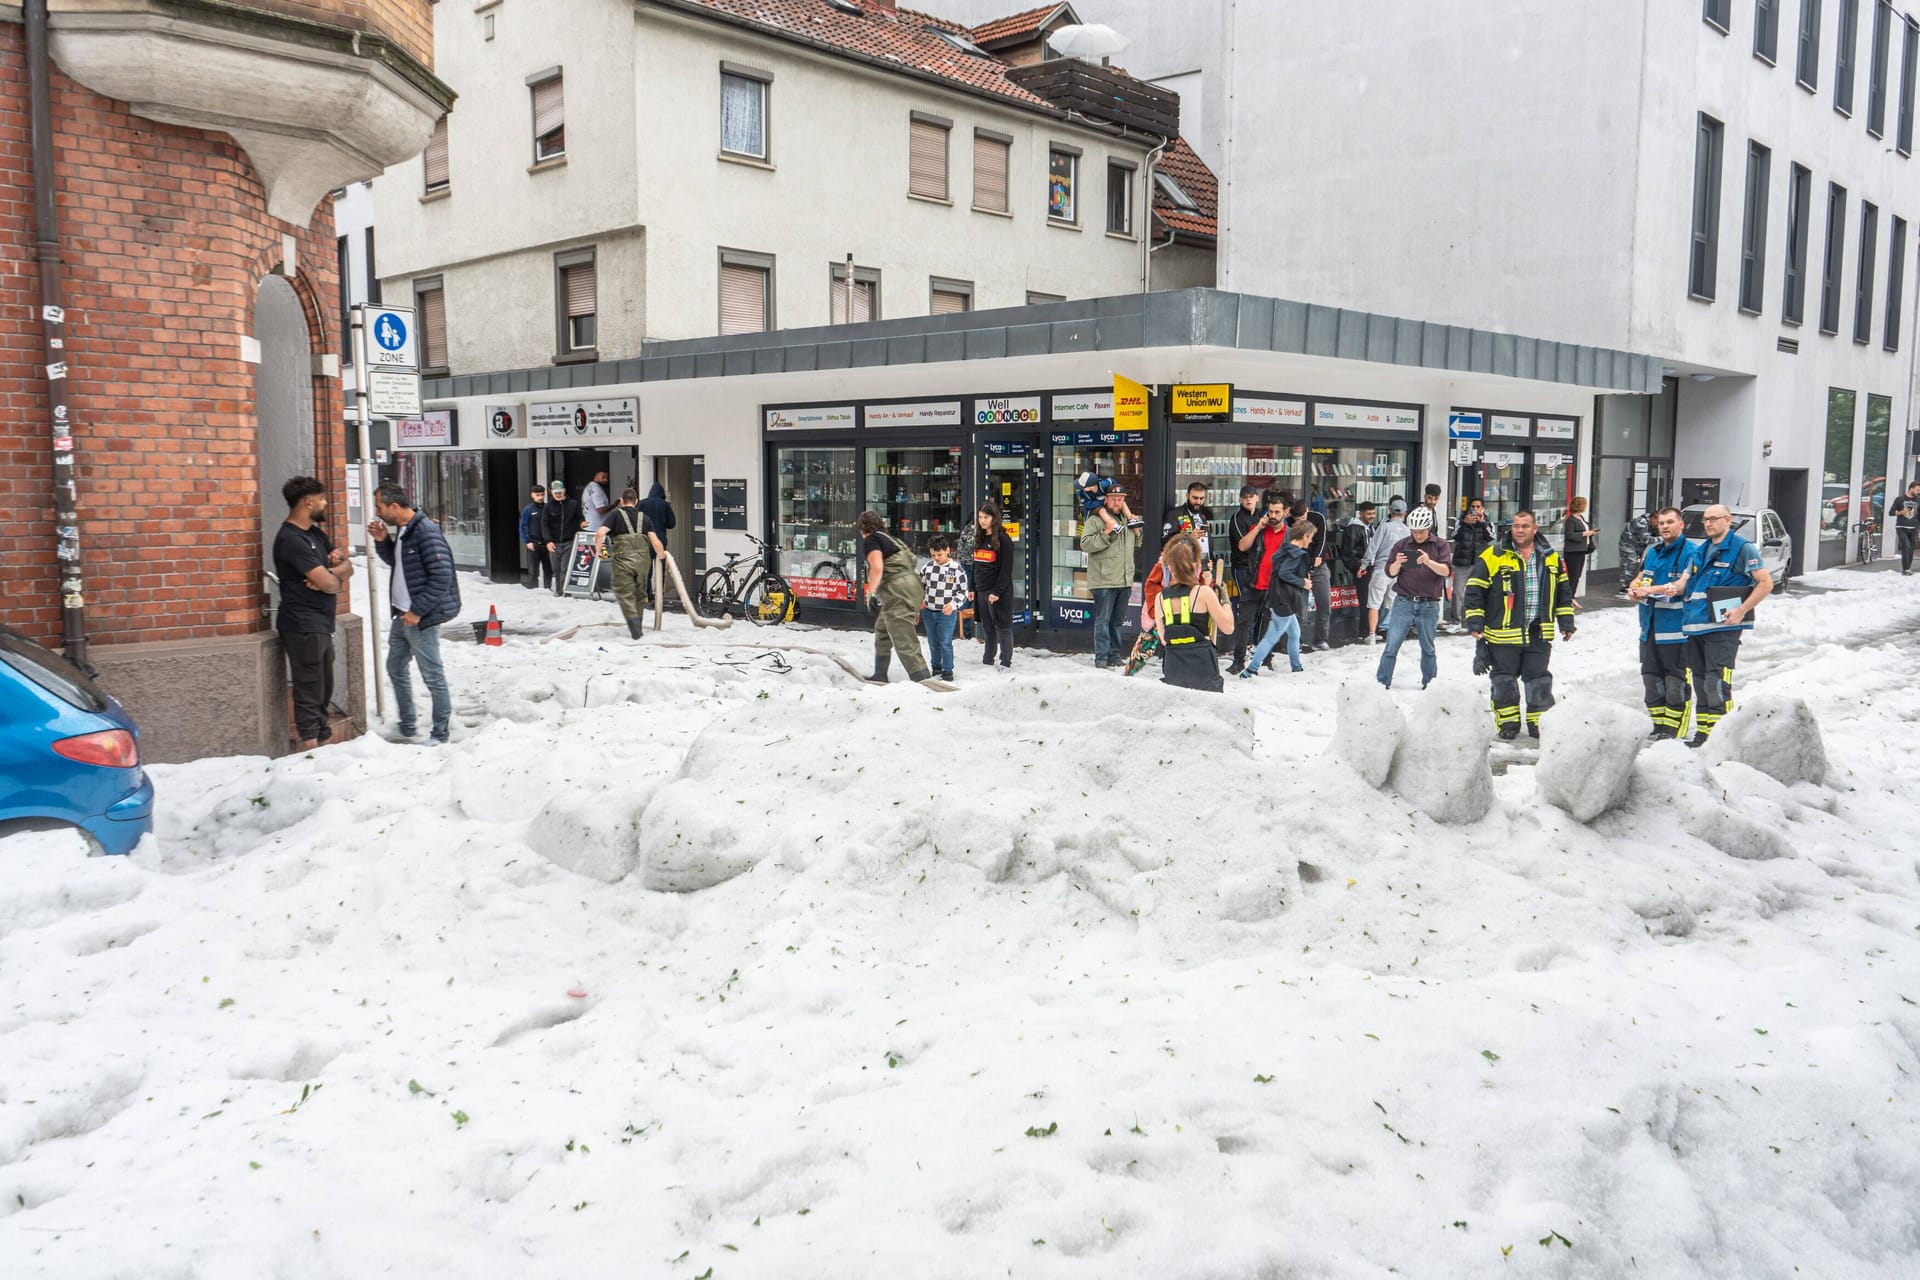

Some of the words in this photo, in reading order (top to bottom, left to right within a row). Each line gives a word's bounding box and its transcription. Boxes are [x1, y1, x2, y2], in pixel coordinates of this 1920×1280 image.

[379, 352, 405, 363] ZONE
[1176, 390, 1208, 398] Western
[988, 400, 1009, 410] Well
[1120, 397, 1142, 405] DHL
[1186, 399, 1208, 407] Union
[1054, 403, 1075, 411] Internet
[978, 408, 1038, 424] CONNECT
[1250, 407, 1266, 416] Handy
[1283, 408, 1302, 417] Verkauf
[1319, 411, 1334, 419] Shisha
[1052, 434, 1066, 442] Lyca
[1100, 433, 1115, 441] Lyca
[990, 443, 1002, 452] Lyca
[1060, 606, 1083, 619] Lyca
